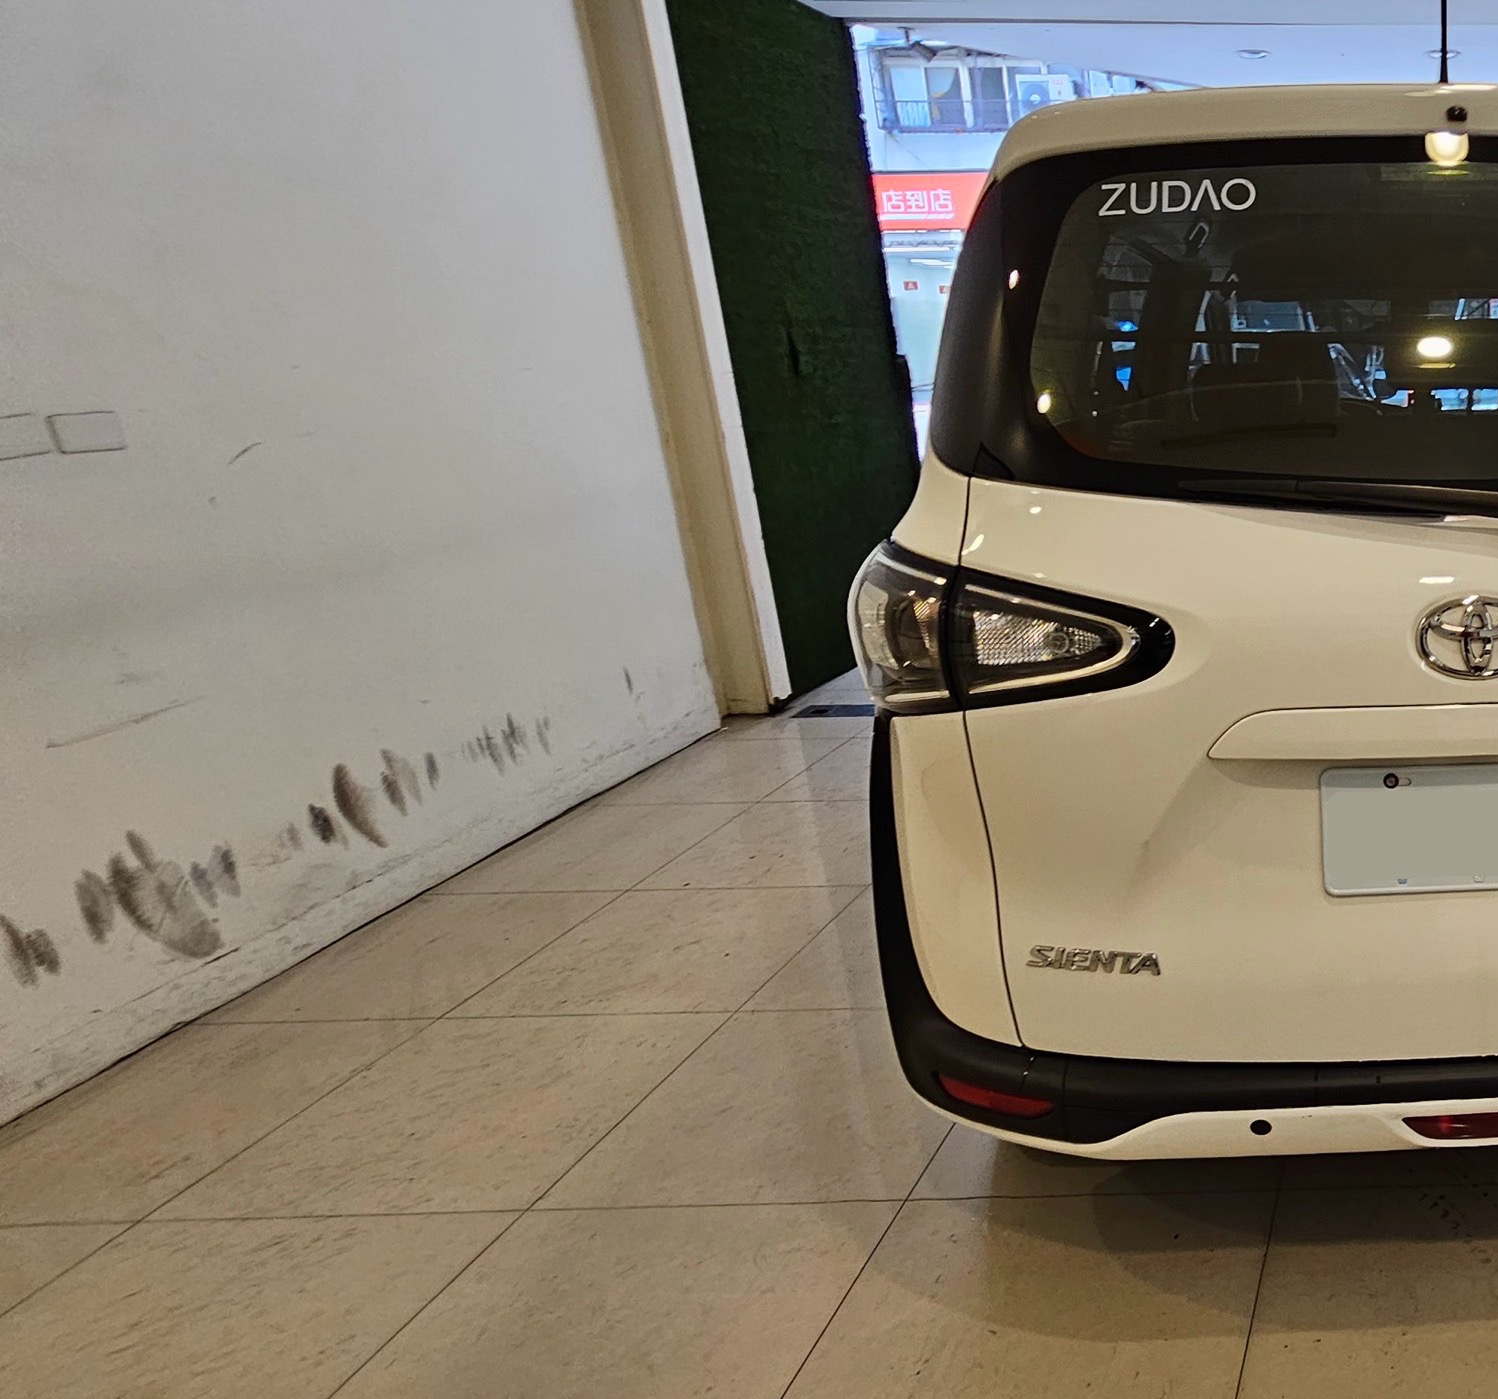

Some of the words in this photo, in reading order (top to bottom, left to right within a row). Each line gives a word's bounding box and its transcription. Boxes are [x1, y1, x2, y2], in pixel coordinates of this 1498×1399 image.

[881, 188, 954, 213] 店到店
[1098, 178, 1257, 217] ZUDAO
[1025, 944, 1162, 976] SIENTA
